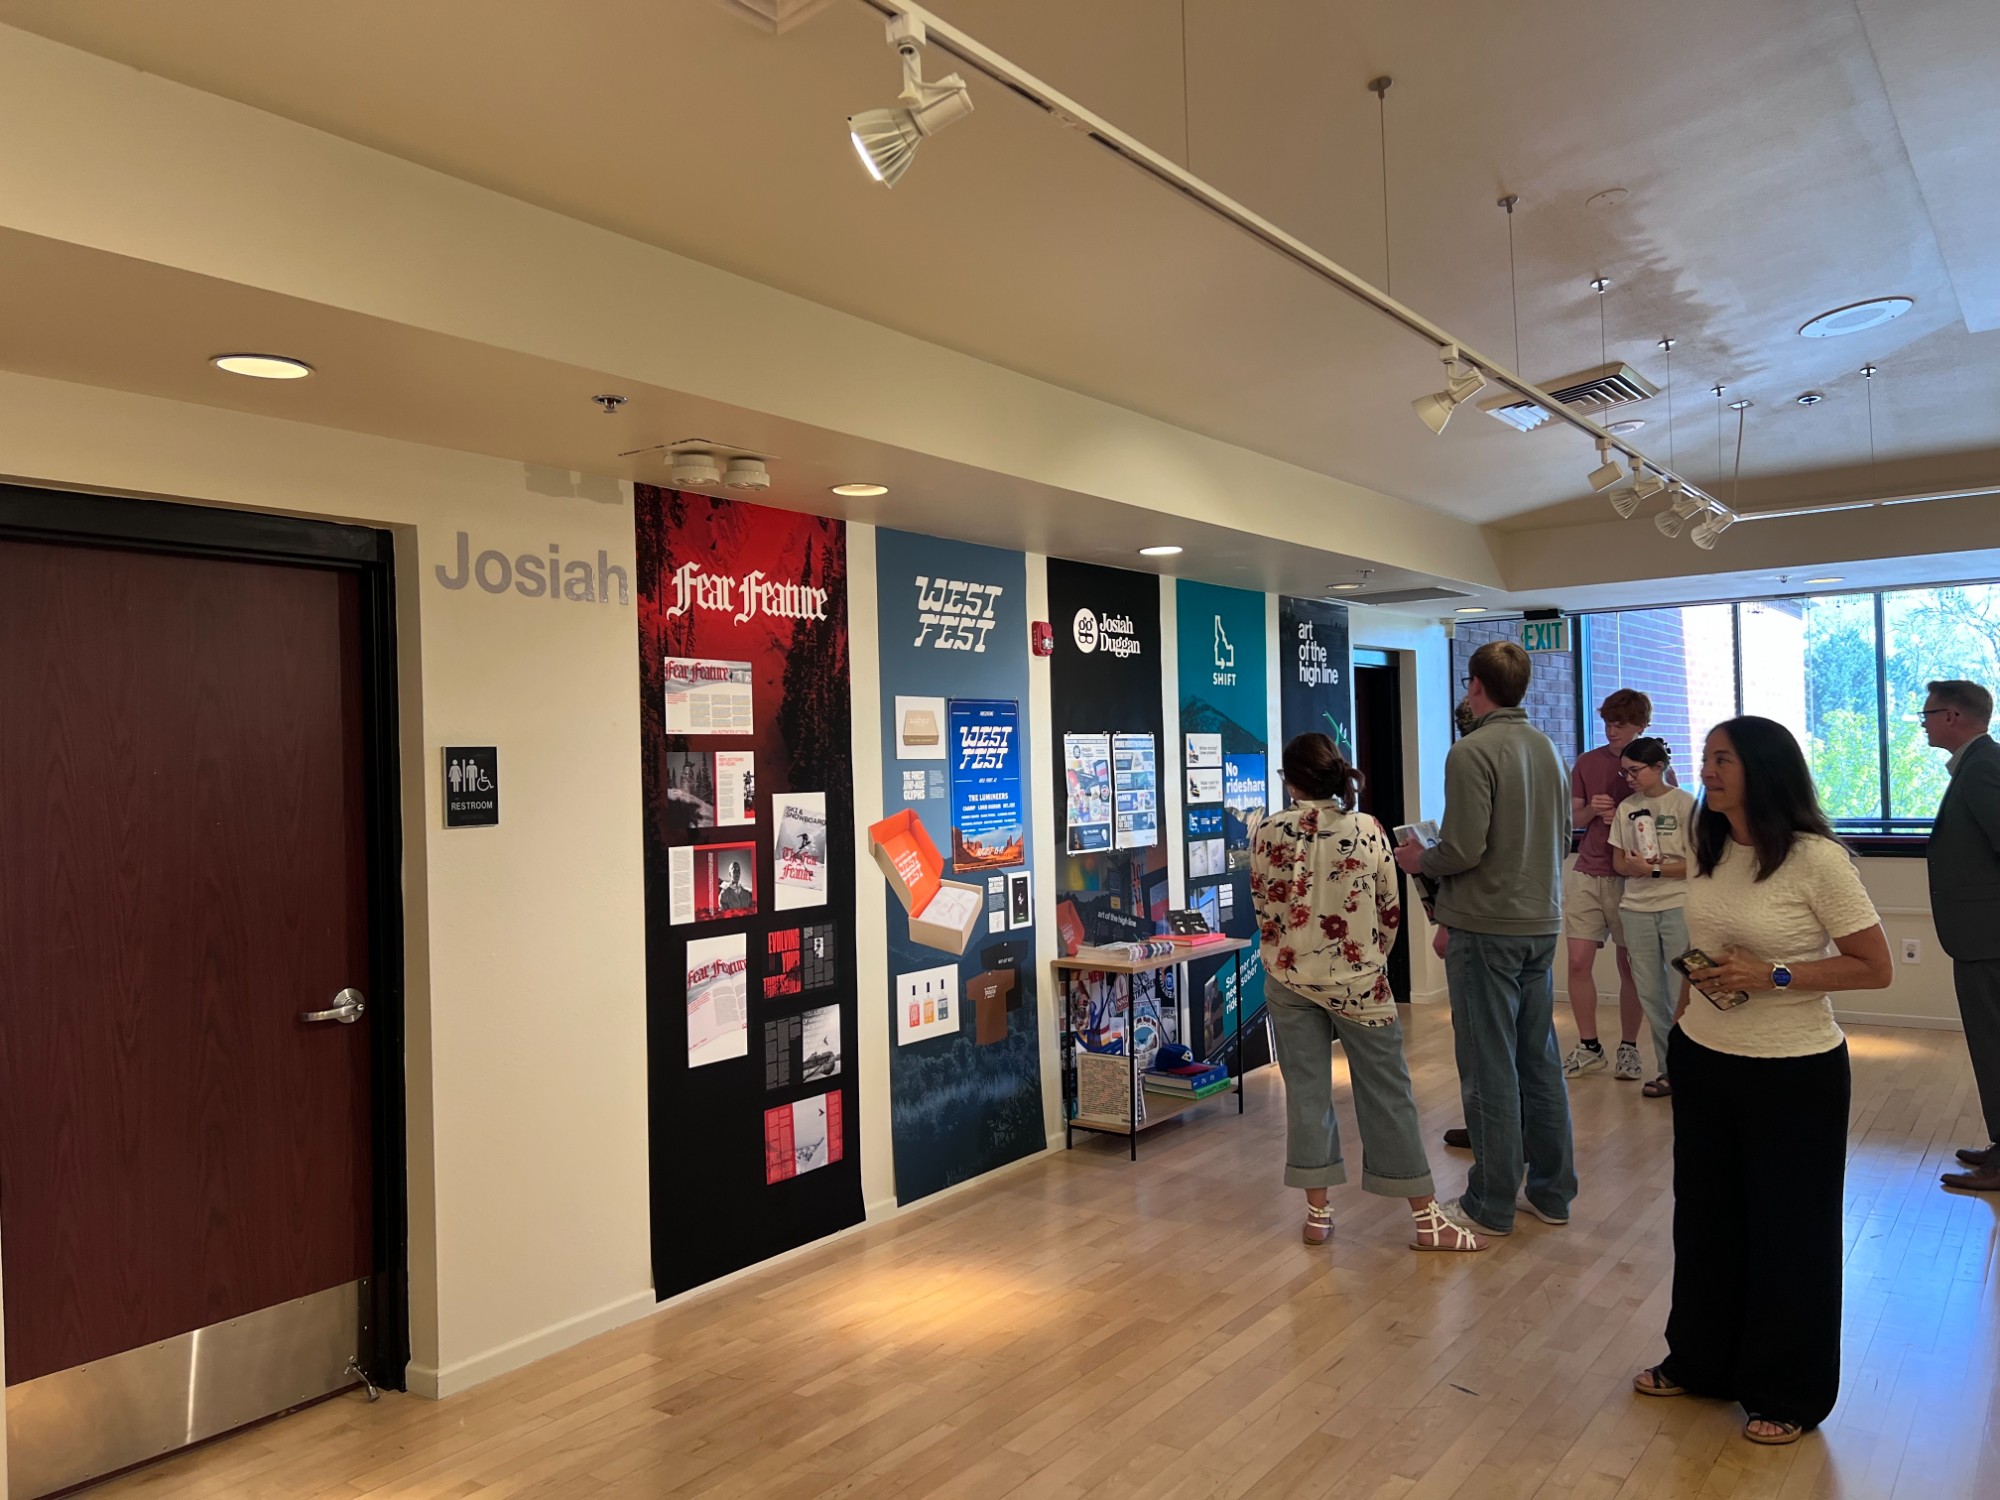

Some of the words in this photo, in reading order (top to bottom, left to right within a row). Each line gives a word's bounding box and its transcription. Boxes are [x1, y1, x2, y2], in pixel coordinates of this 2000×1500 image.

[435, 531, 629, 605] Josiah
[666, 561, 736, 621] Fear
[734, 570, 828, 627] Feature
[915, 576, 1003, 618] WEST
[914, 614, 996, 653] FEST
[1100, 613, 1134, 634] Josiah
[1298, 620, 1313, 640] art
[1100, 633, 1141, 658] Duggan
[1524, 622, 1562, 650] EXIT
[1299, 640, 1311, 661] of
[1311, 641, 1327, 662] the
[1213, 672, 1236, 686] SHIFT
[1299, 661, 1321, 687] high
[1321, 663, 1339, 685] line
[959, 726, 1012, 748] WEST
[959, 748, 1008, 770] FEST
[1225, 762, 1238, 777] No
[1226, 778, 1265, 793] rideshare
[451, 800, 493, 810] RESTROOM
[1241, 963, 1257, 987] sober
